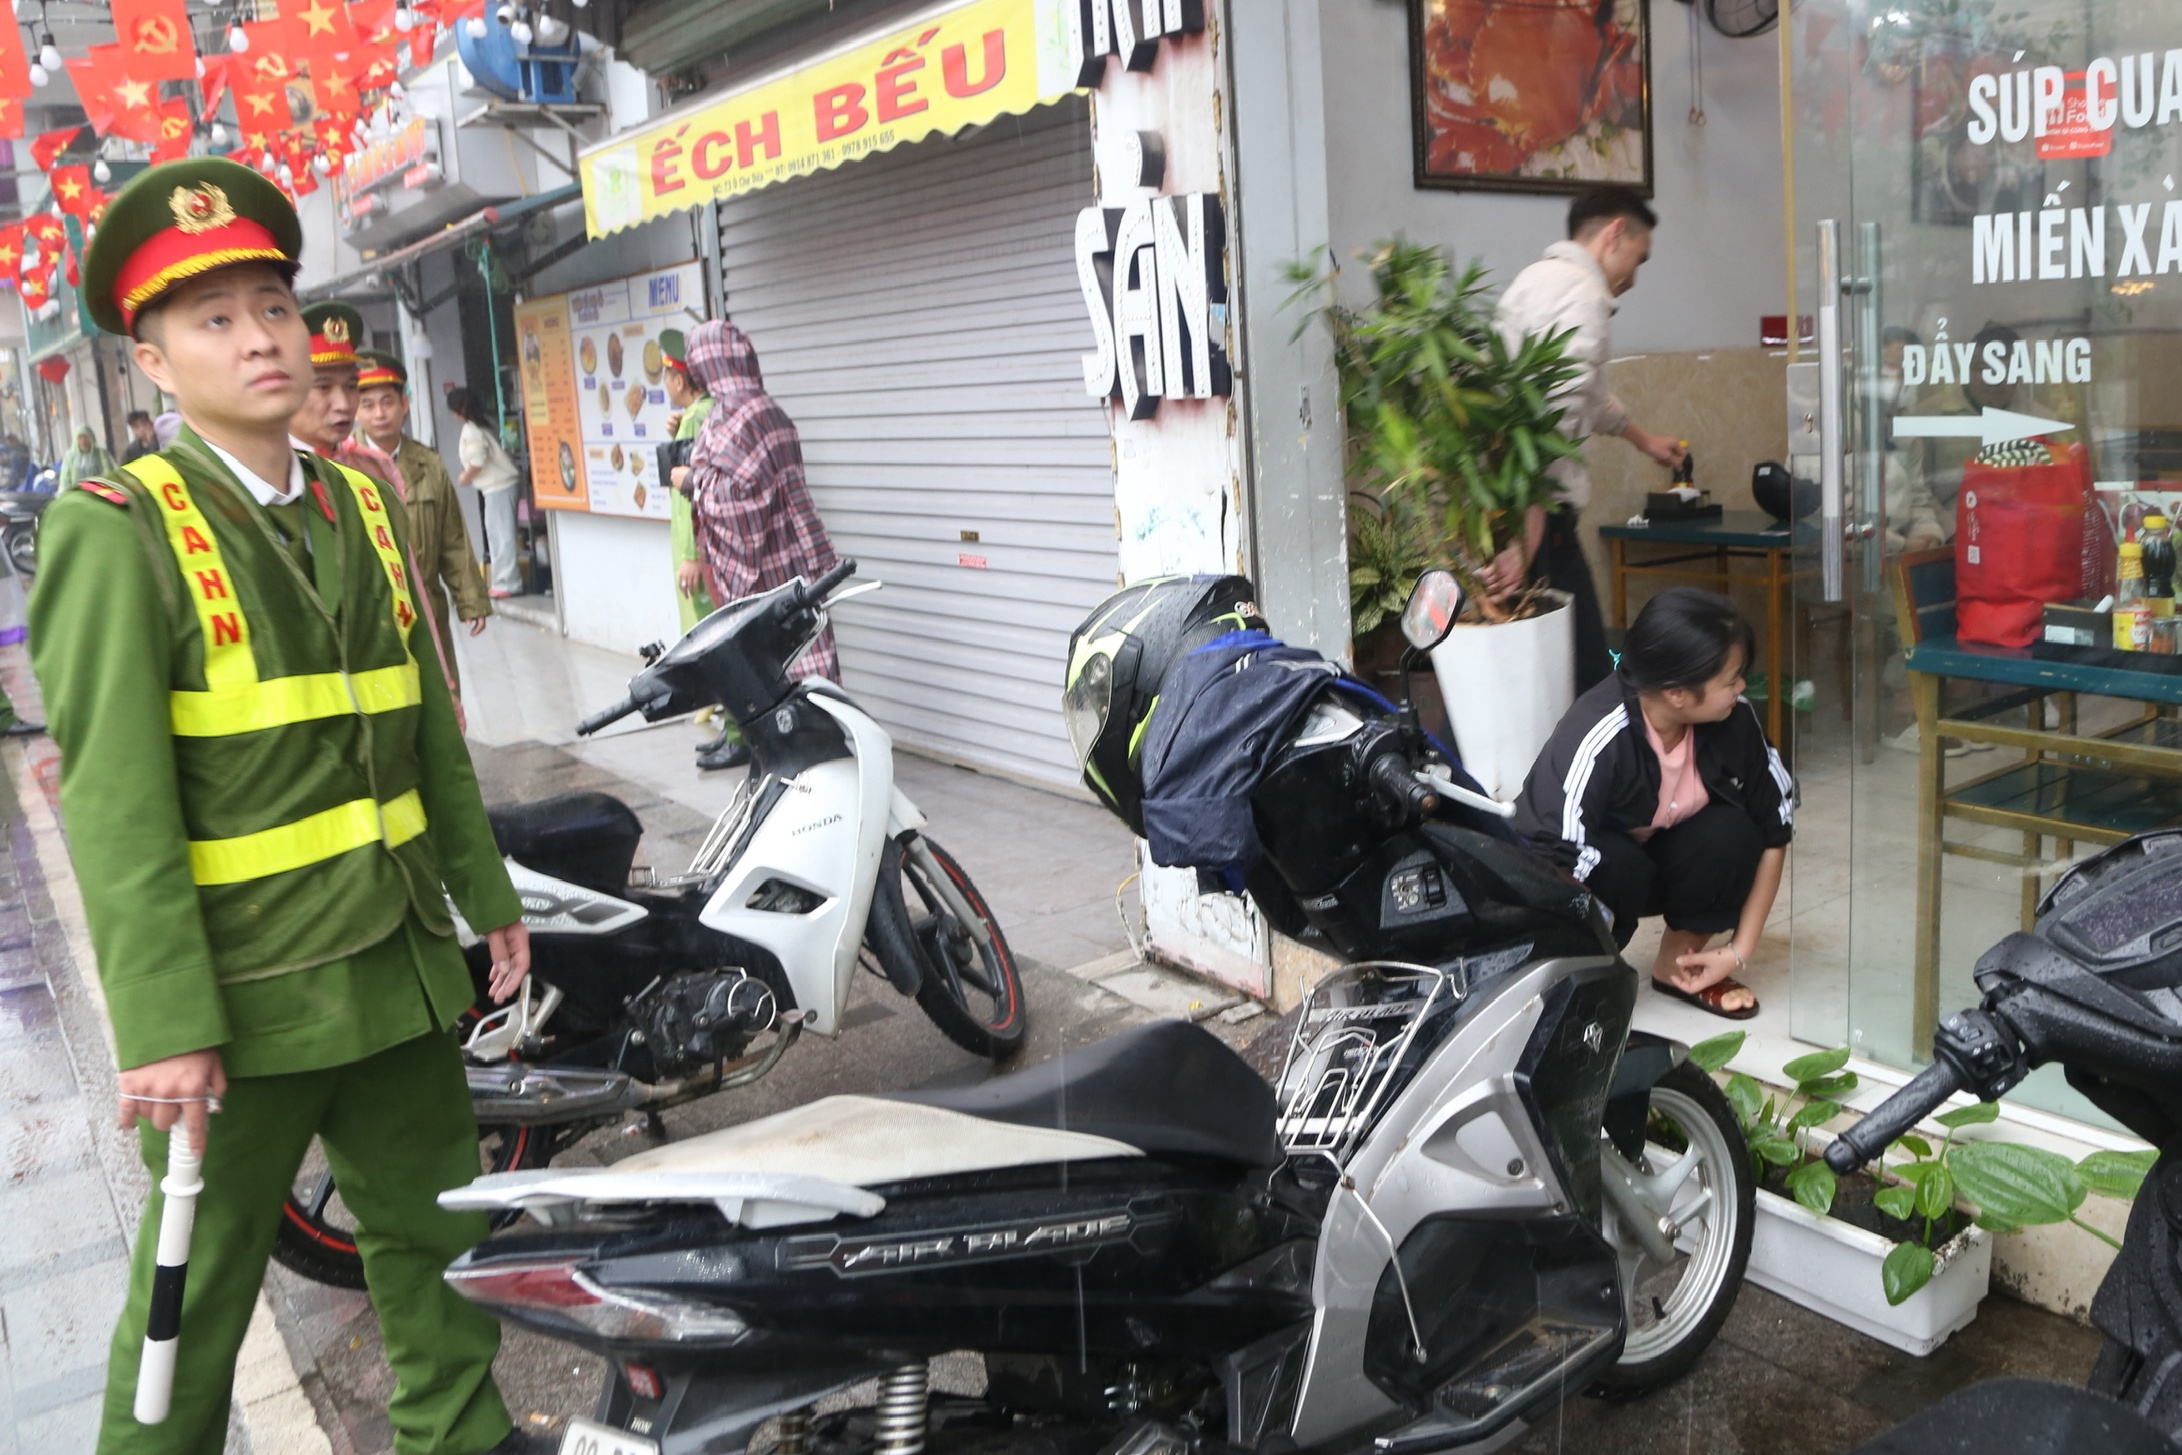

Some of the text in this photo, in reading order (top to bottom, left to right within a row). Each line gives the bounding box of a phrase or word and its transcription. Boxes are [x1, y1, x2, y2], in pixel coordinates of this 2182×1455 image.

[651, 110, 782, 197] ẾCH
[813, 26, 1006, 143] BẾU
[1968, 47, 2182, 145] SÚP CUA
[1075, 130, 1212, 421] SẢN
[1972, 173, 2182, 285] MIẾN XÀ
[649, 273, 679, 308] MENU
[1902, 317, 2091, 386] ĐẨY SANG
[161, 482, 242, 647] CAHN
[792, 813, 842, 837] HONDA
